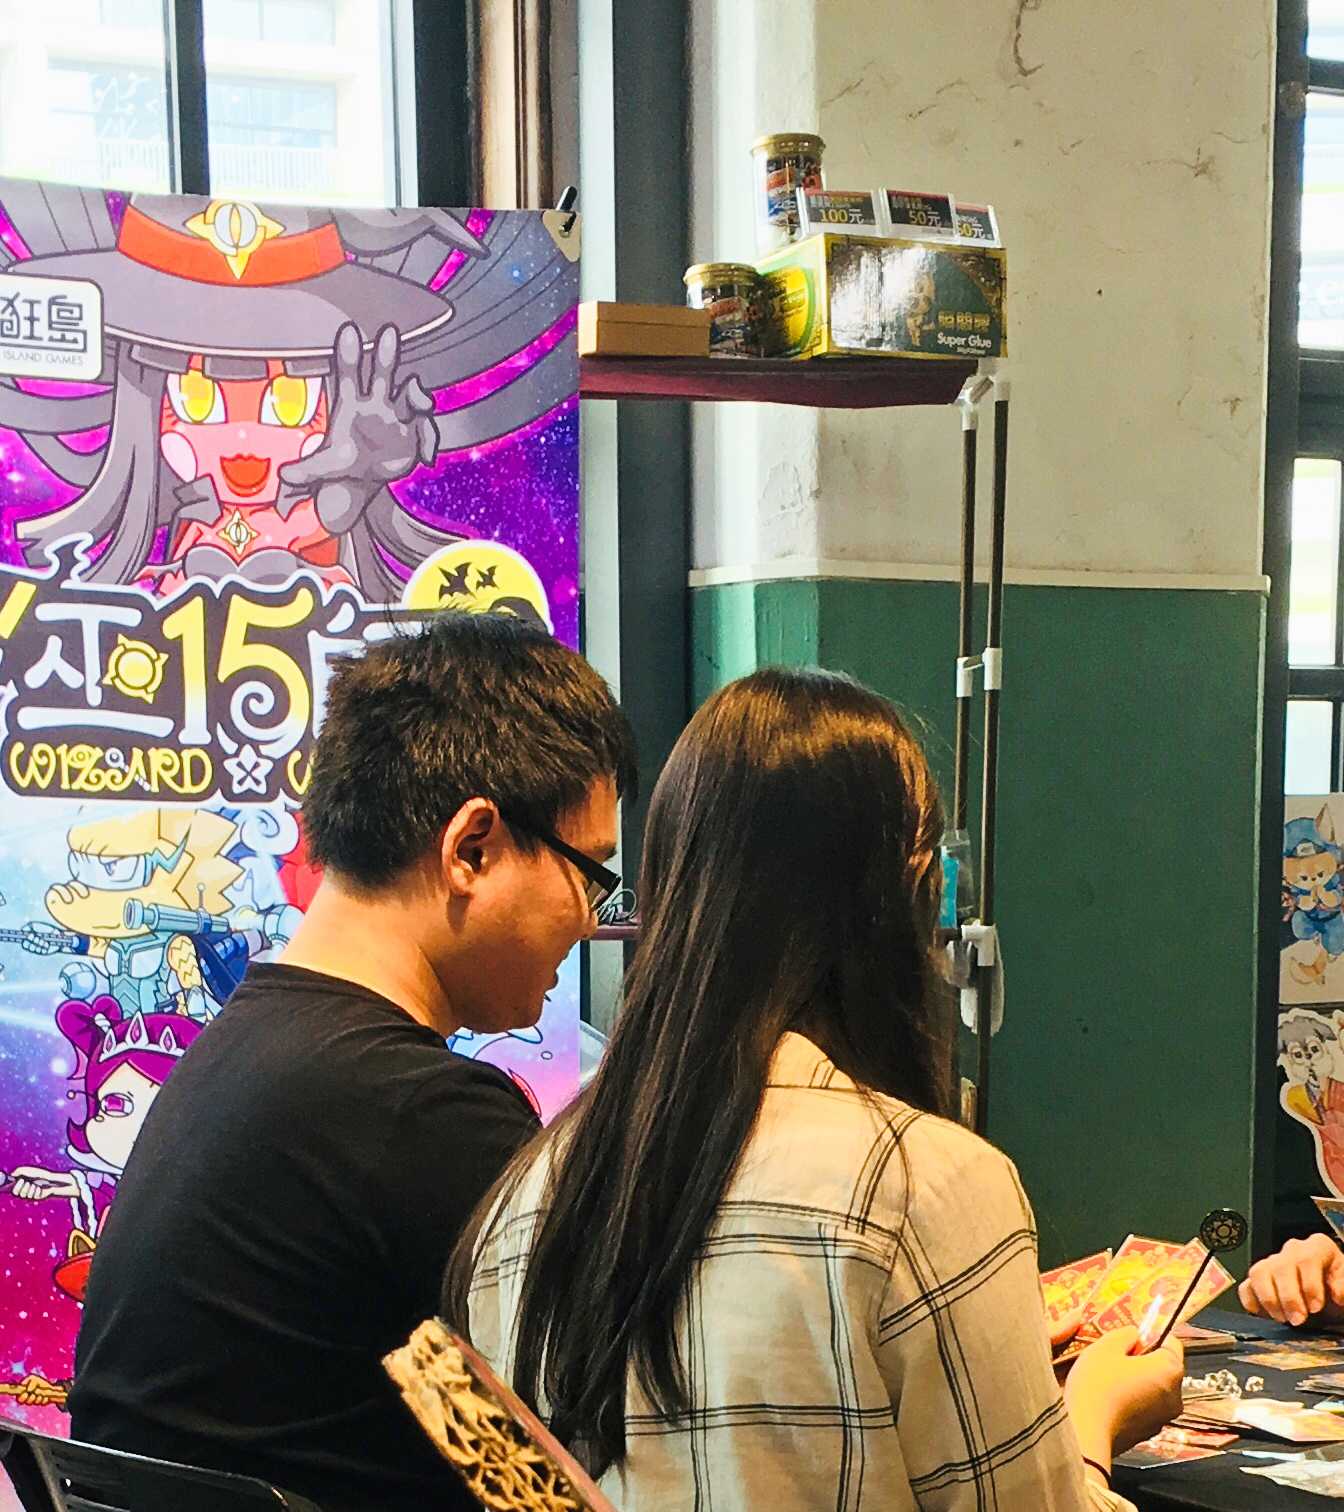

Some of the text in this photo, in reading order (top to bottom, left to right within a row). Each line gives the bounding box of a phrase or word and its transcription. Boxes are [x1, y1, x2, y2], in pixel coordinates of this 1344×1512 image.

[3, 347, 42, 363] ISLAND
[46, 353, 84, 366] GAMES
[937, 332, 992, 349] Super Glue
[17, 585, 361, 752] 巫15
[9, 744, 213, 794] WIZARD
